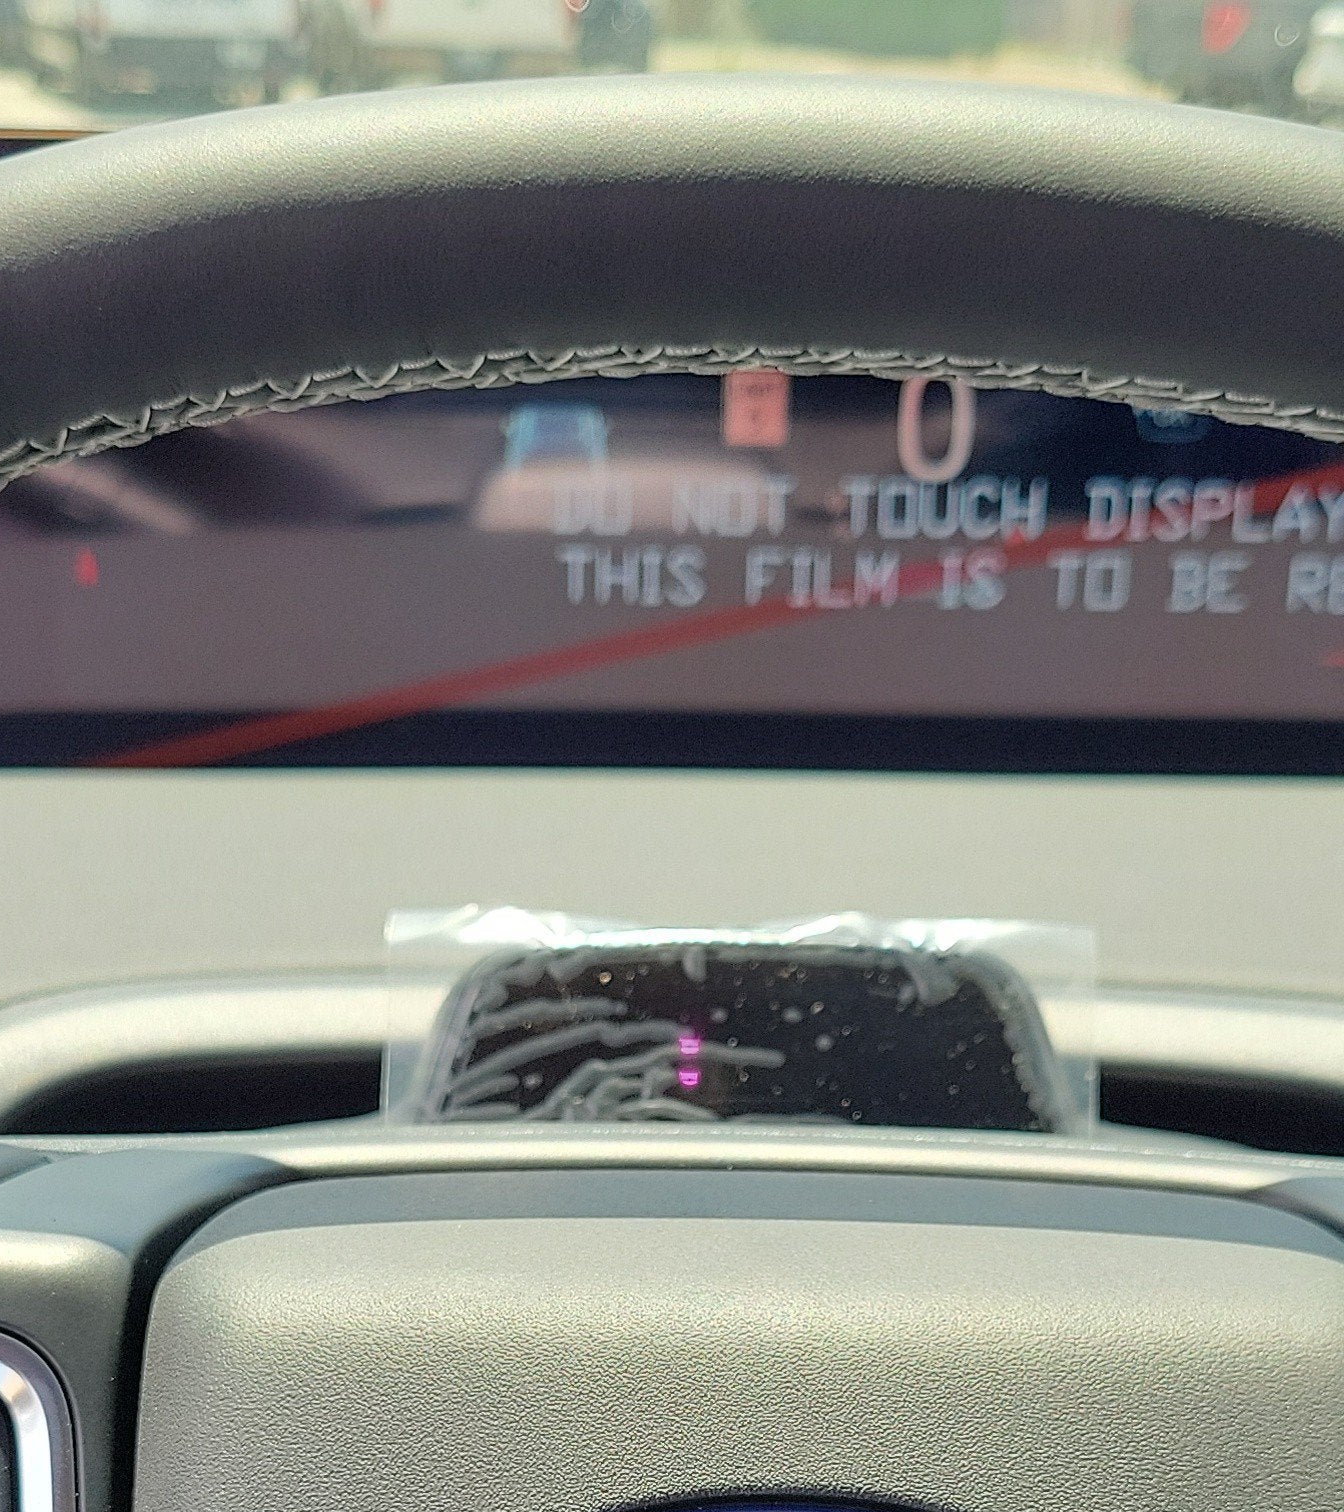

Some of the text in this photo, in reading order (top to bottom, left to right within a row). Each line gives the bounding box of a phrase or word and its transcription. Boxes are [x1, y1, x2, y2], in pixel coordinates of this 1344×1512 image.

[555, 476, 634, 537] DO
[670, 474, 794, 537] NOT
[842, 474, 1052, 542] TOUCH
[559, 543, 707, 610] THIS
[744, 546, 900, 611] FILM
[936, 546, 1010, 612] IS
[1049, 549, 1132, 614] TO
[1169, 550, 1252, 615] BE
